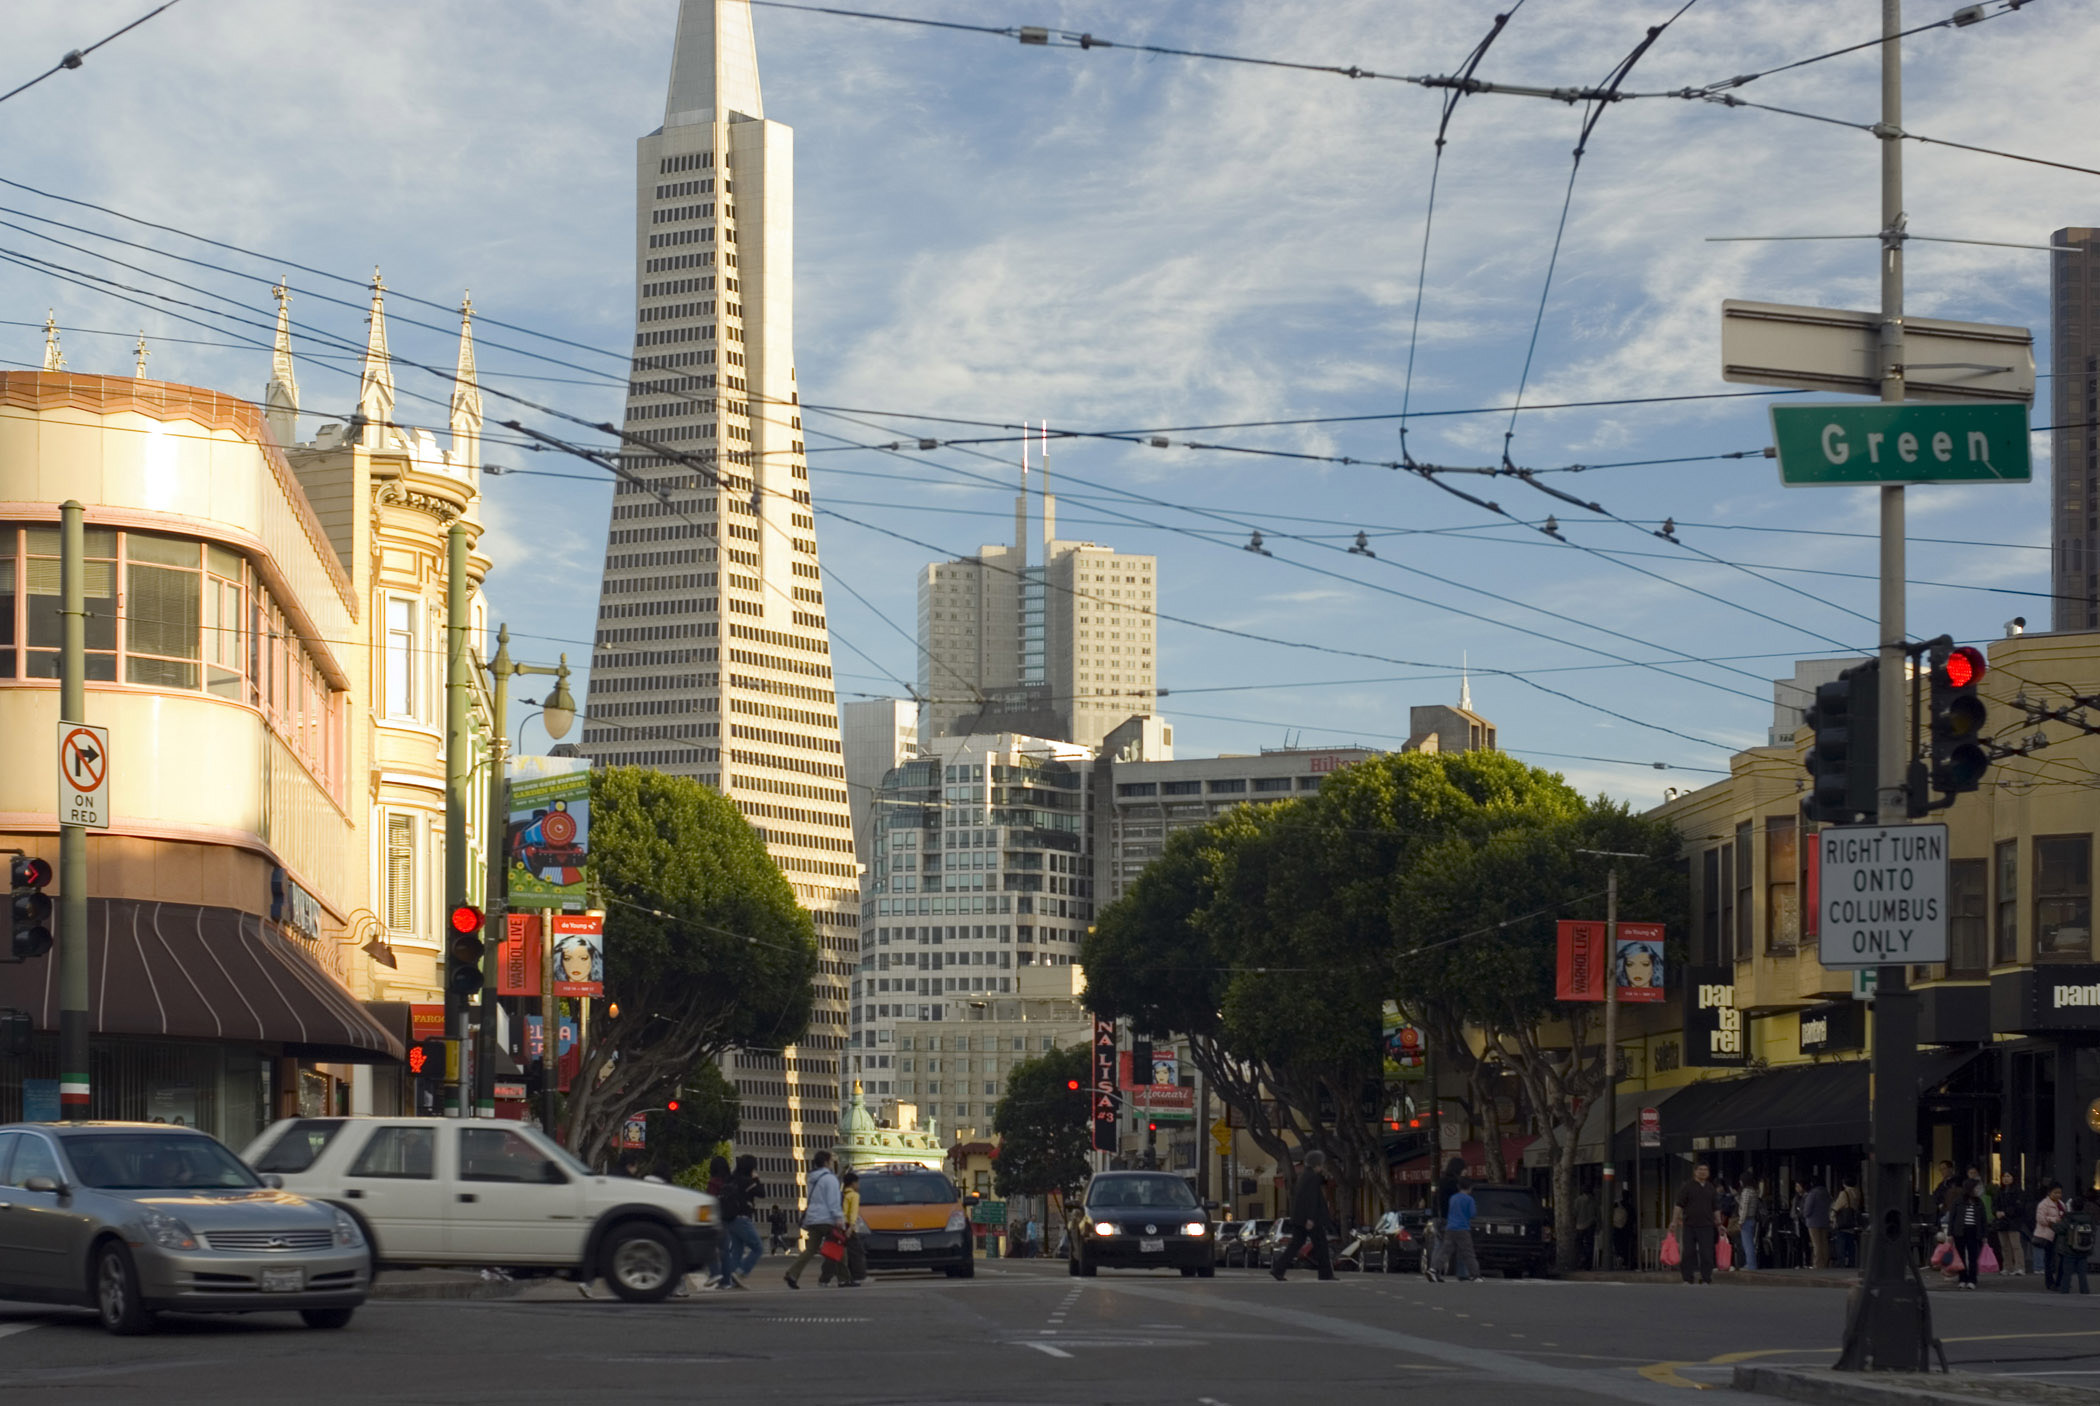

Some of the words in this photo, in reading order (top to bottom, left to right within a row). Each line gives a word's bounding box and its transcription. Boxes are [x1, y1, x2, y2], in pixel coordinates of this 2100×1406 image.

[1821, 423, 1989, 465] Green
[75, 794, 94, 808] ON
[513, 787, 548, 799] GARDEN
[549, 780, 587, 792] RAILWAY
[71, 809, 98, 823] RED
[1826, 838, 1882, 864] RIGHT
[1891, 836, 1941, 862] TURN
[1853, 867, 1914, 892] ONTO
[1829, 898, 1938, 924] COLUMBUS
[510, 919, 524, 942] LIVE
[569, 922, 587, 930] Young
[1575, 926, 1588, 949] LIVE
[1853, 929, 1914, 954] ONLY
[510, 946, 524, 989] WARHOL
[1575, 953, 1588, 993] WARHOL
[1718, 1007, 1740, 1030] ta
[1710, 1030, 1741, 1053] rei
[1097, 1053, 1114, 1107] LISA
[1097, 1111, 1114, 1122] #3
